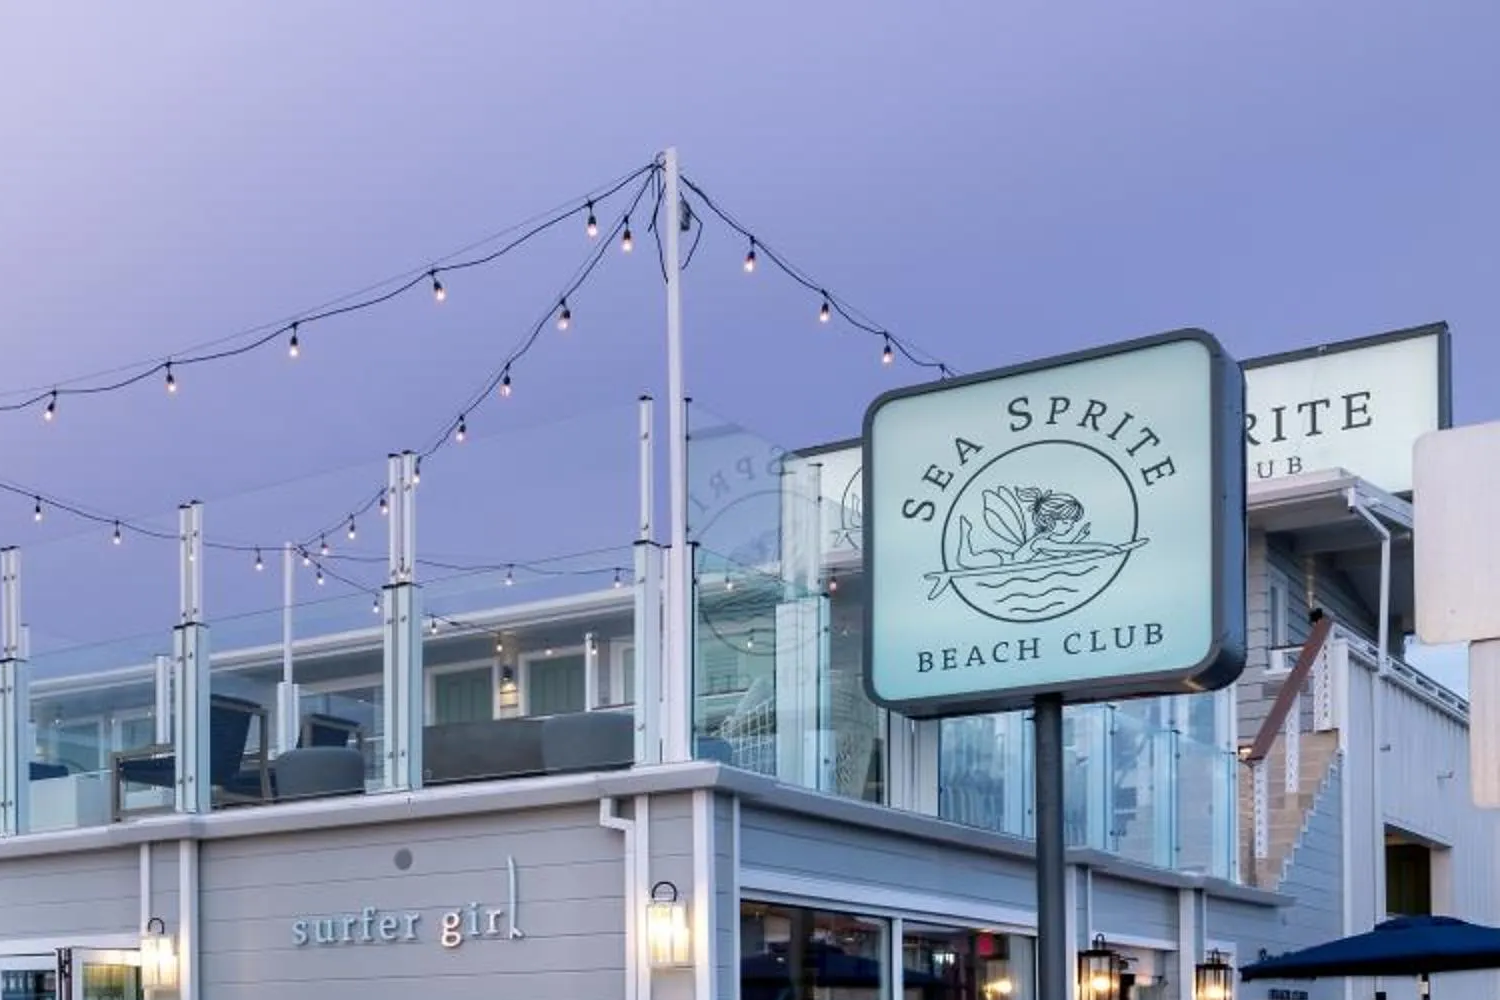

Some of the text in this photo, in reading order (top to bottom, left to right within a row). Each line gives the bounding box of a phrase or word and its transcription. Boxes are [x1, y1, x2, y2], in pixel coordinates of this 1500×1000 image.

[901, 396, 1176, 522] SEA SPRITE
[917, 623, 1164, 672] BEACH CLUB
[291, 855, 525, 947] surfer girl
